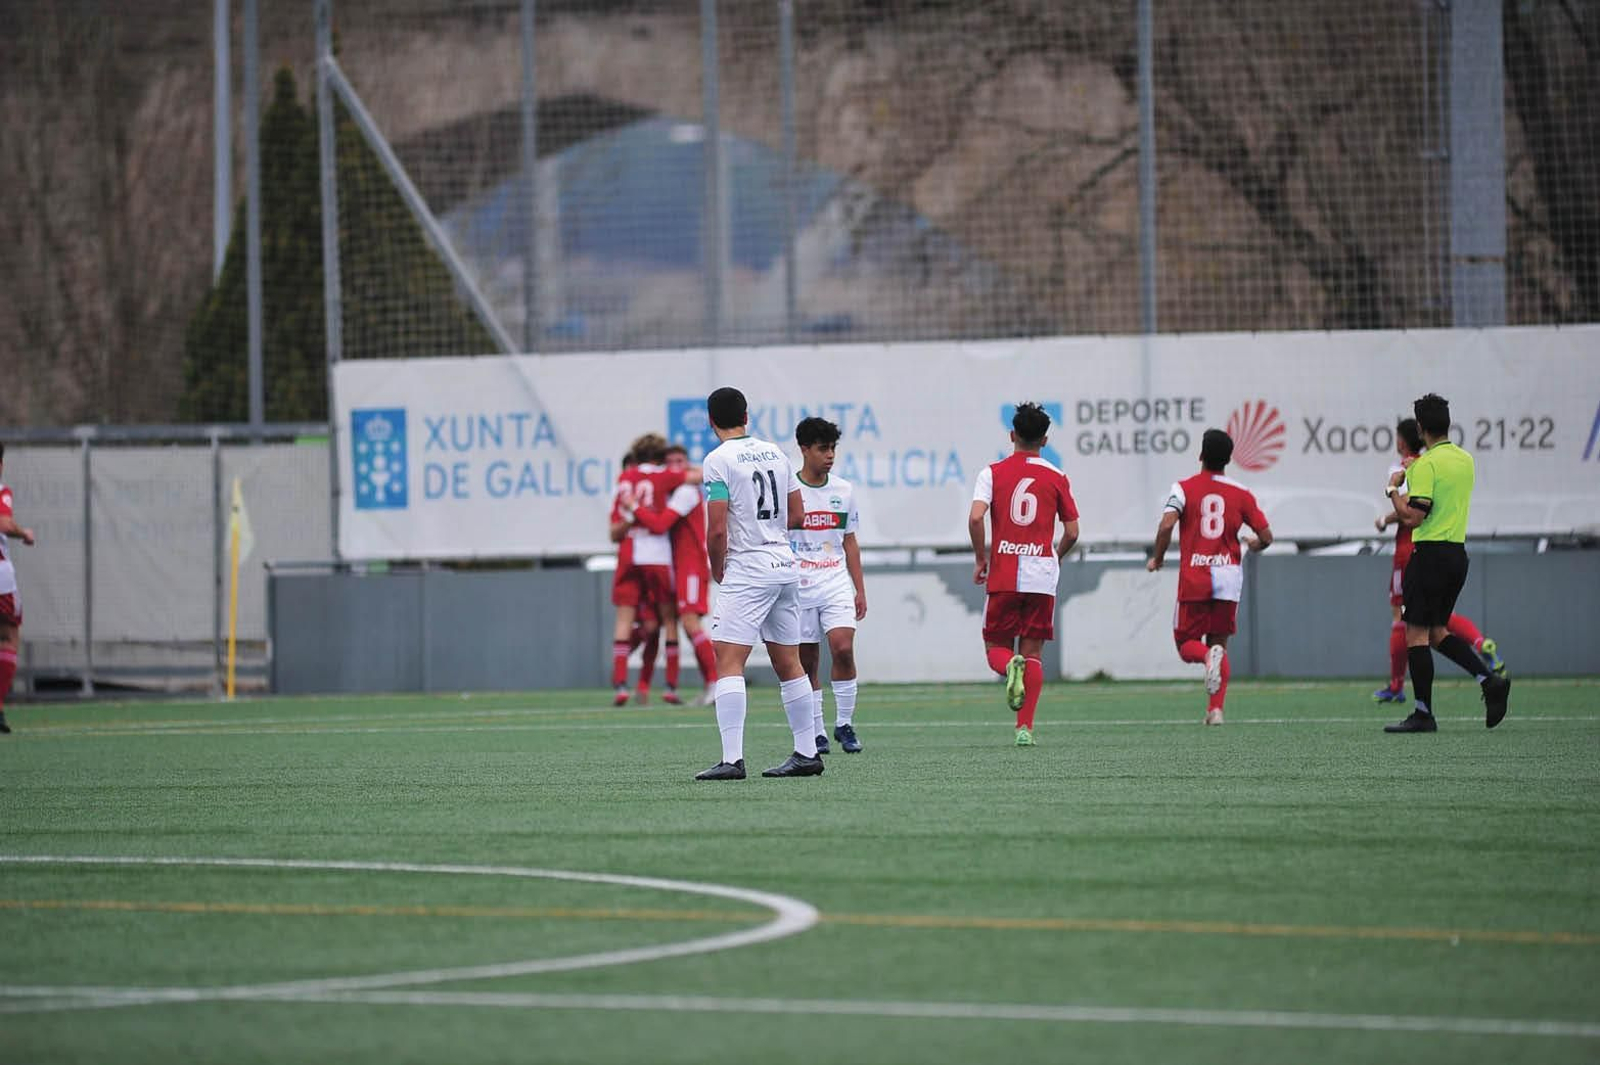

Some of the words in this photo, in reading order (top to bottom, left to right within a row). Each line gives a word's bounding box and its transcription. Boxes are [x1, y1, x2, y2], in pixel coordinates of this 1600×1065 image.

[1076, 398, 1205, 424] DEPORTE
[424, 412, 558, 452] XUNTA
[1076, 430, 1190, 455] GALEGO
[424, 462, 469, 500] DE
[485, 457, 611, 499] GALICI
[752, 470, 780, 521] 21
[803, 514, 837, 528] ABRIL
[1010, 478, 1038, 526] 6
[1200, 494, 1225, 539] 8
